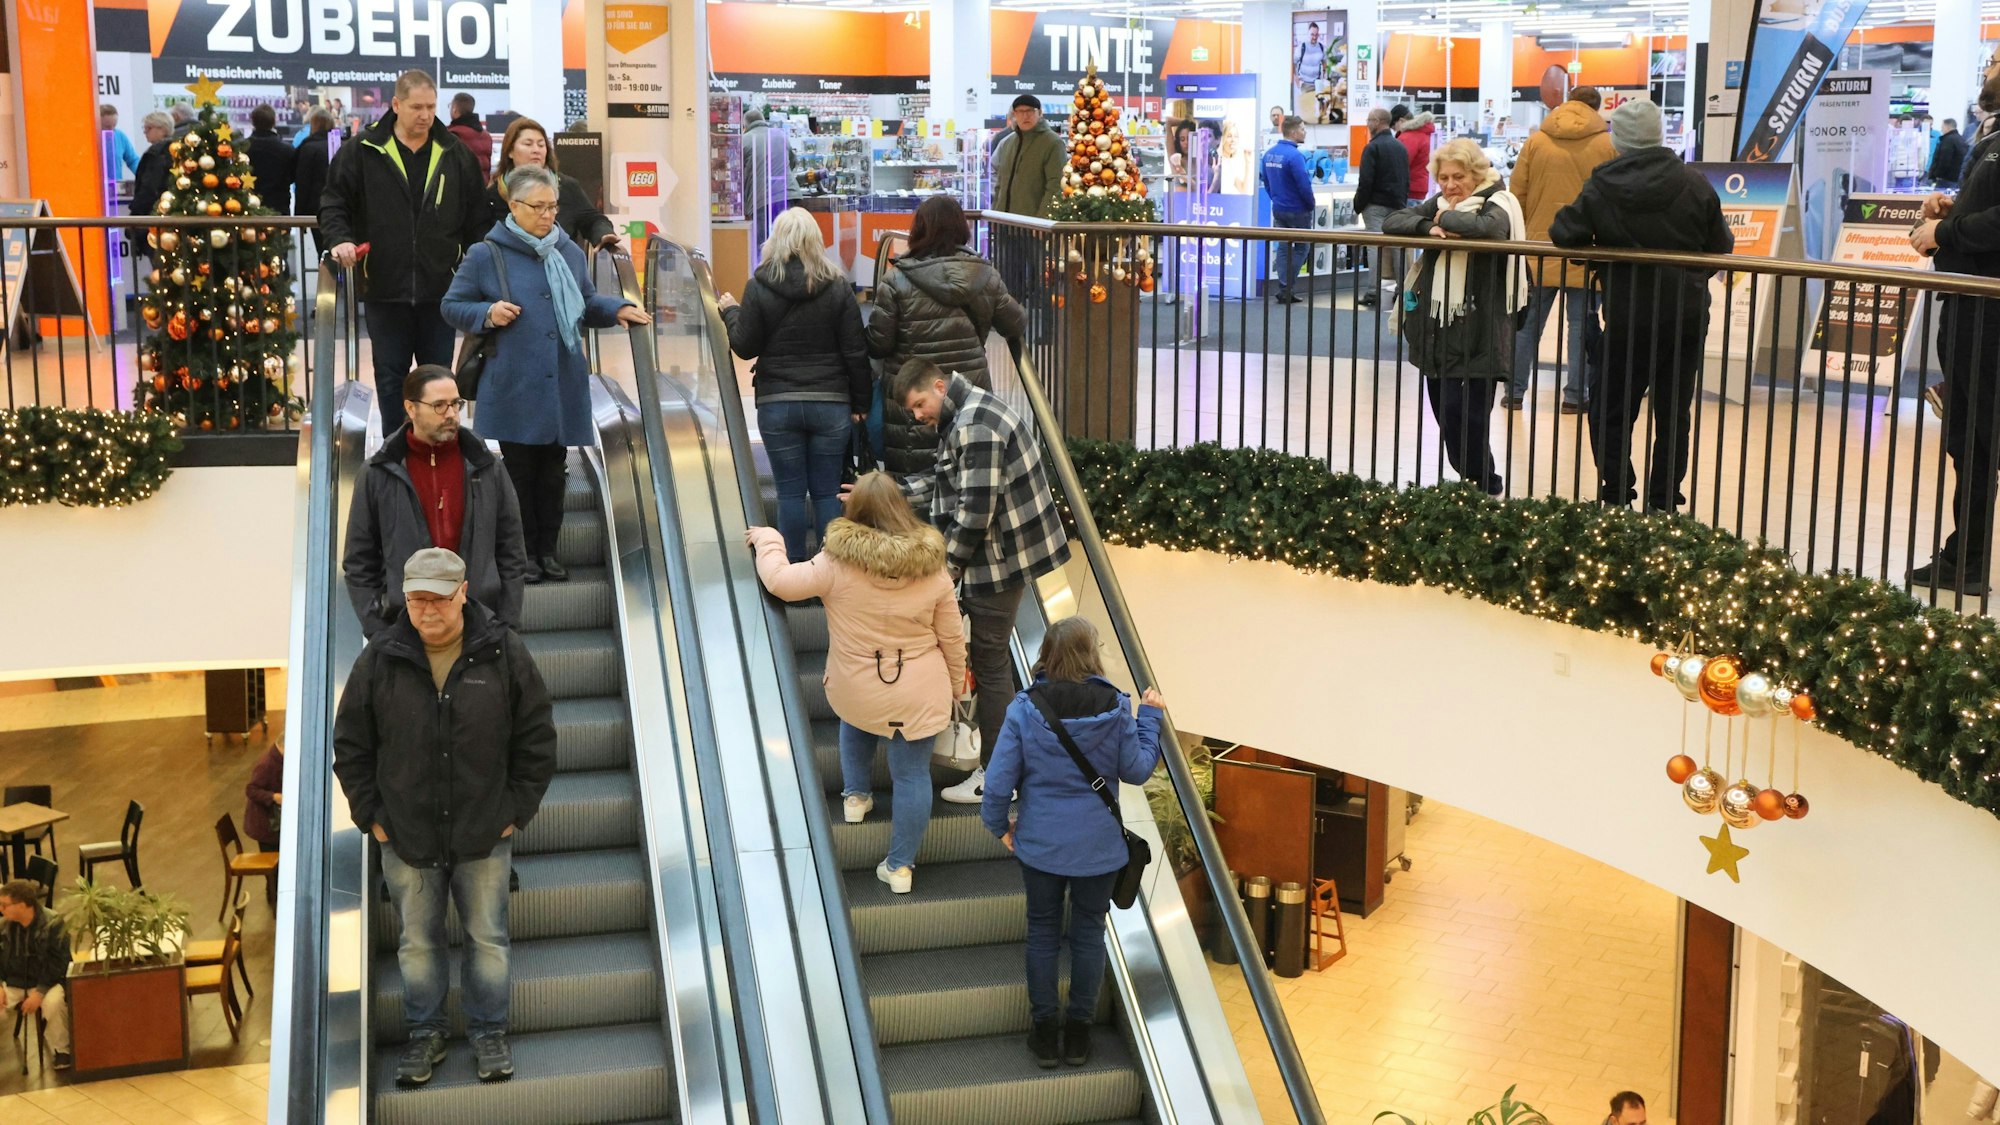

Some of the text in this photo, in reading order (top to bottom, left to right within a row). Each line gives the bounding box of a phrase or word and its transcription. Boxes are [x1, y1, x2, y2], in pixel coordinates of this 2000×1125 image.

[1044, 24, 1153, 74] TINTE
[307, 67, 331, 83] App
[331, 70, 397, 84] gesteuertes
[446, 71, 510, 85] Leuchtmitte
[622, 73, 632, 81] Sa.
[629, 83, 649, 91] 19:00
[651, 83, 662, 91] Uhr
[762, 78, 797, 90] Zubehör
[819, 79, 842, 90] Toner
[1014, 79, 1035, 91] Toner
[1052, 81, 1075, 94] Papier
[1829, 80, 1869, 92] SATURN
[1768, 52, 1823, 134] SATURN
[1196, 104, 1224, 112] PHILIPS
[1355, 97, 1370, 108] WiFi
[1809, 126, 1847, 137] HONOR
[557, 138, 599, 146] ANGEBOTE
[630, 172, 655, 186] LEGO
[1725, 173, 1748, 199] O2
[1210, 206, 1224, 217] zu
[1878, 206, 1922, 219] freene
[1845, 233, 1911, 247] Öffnungszeiten
[1862, 250, 1920, 263] Weihnachten
